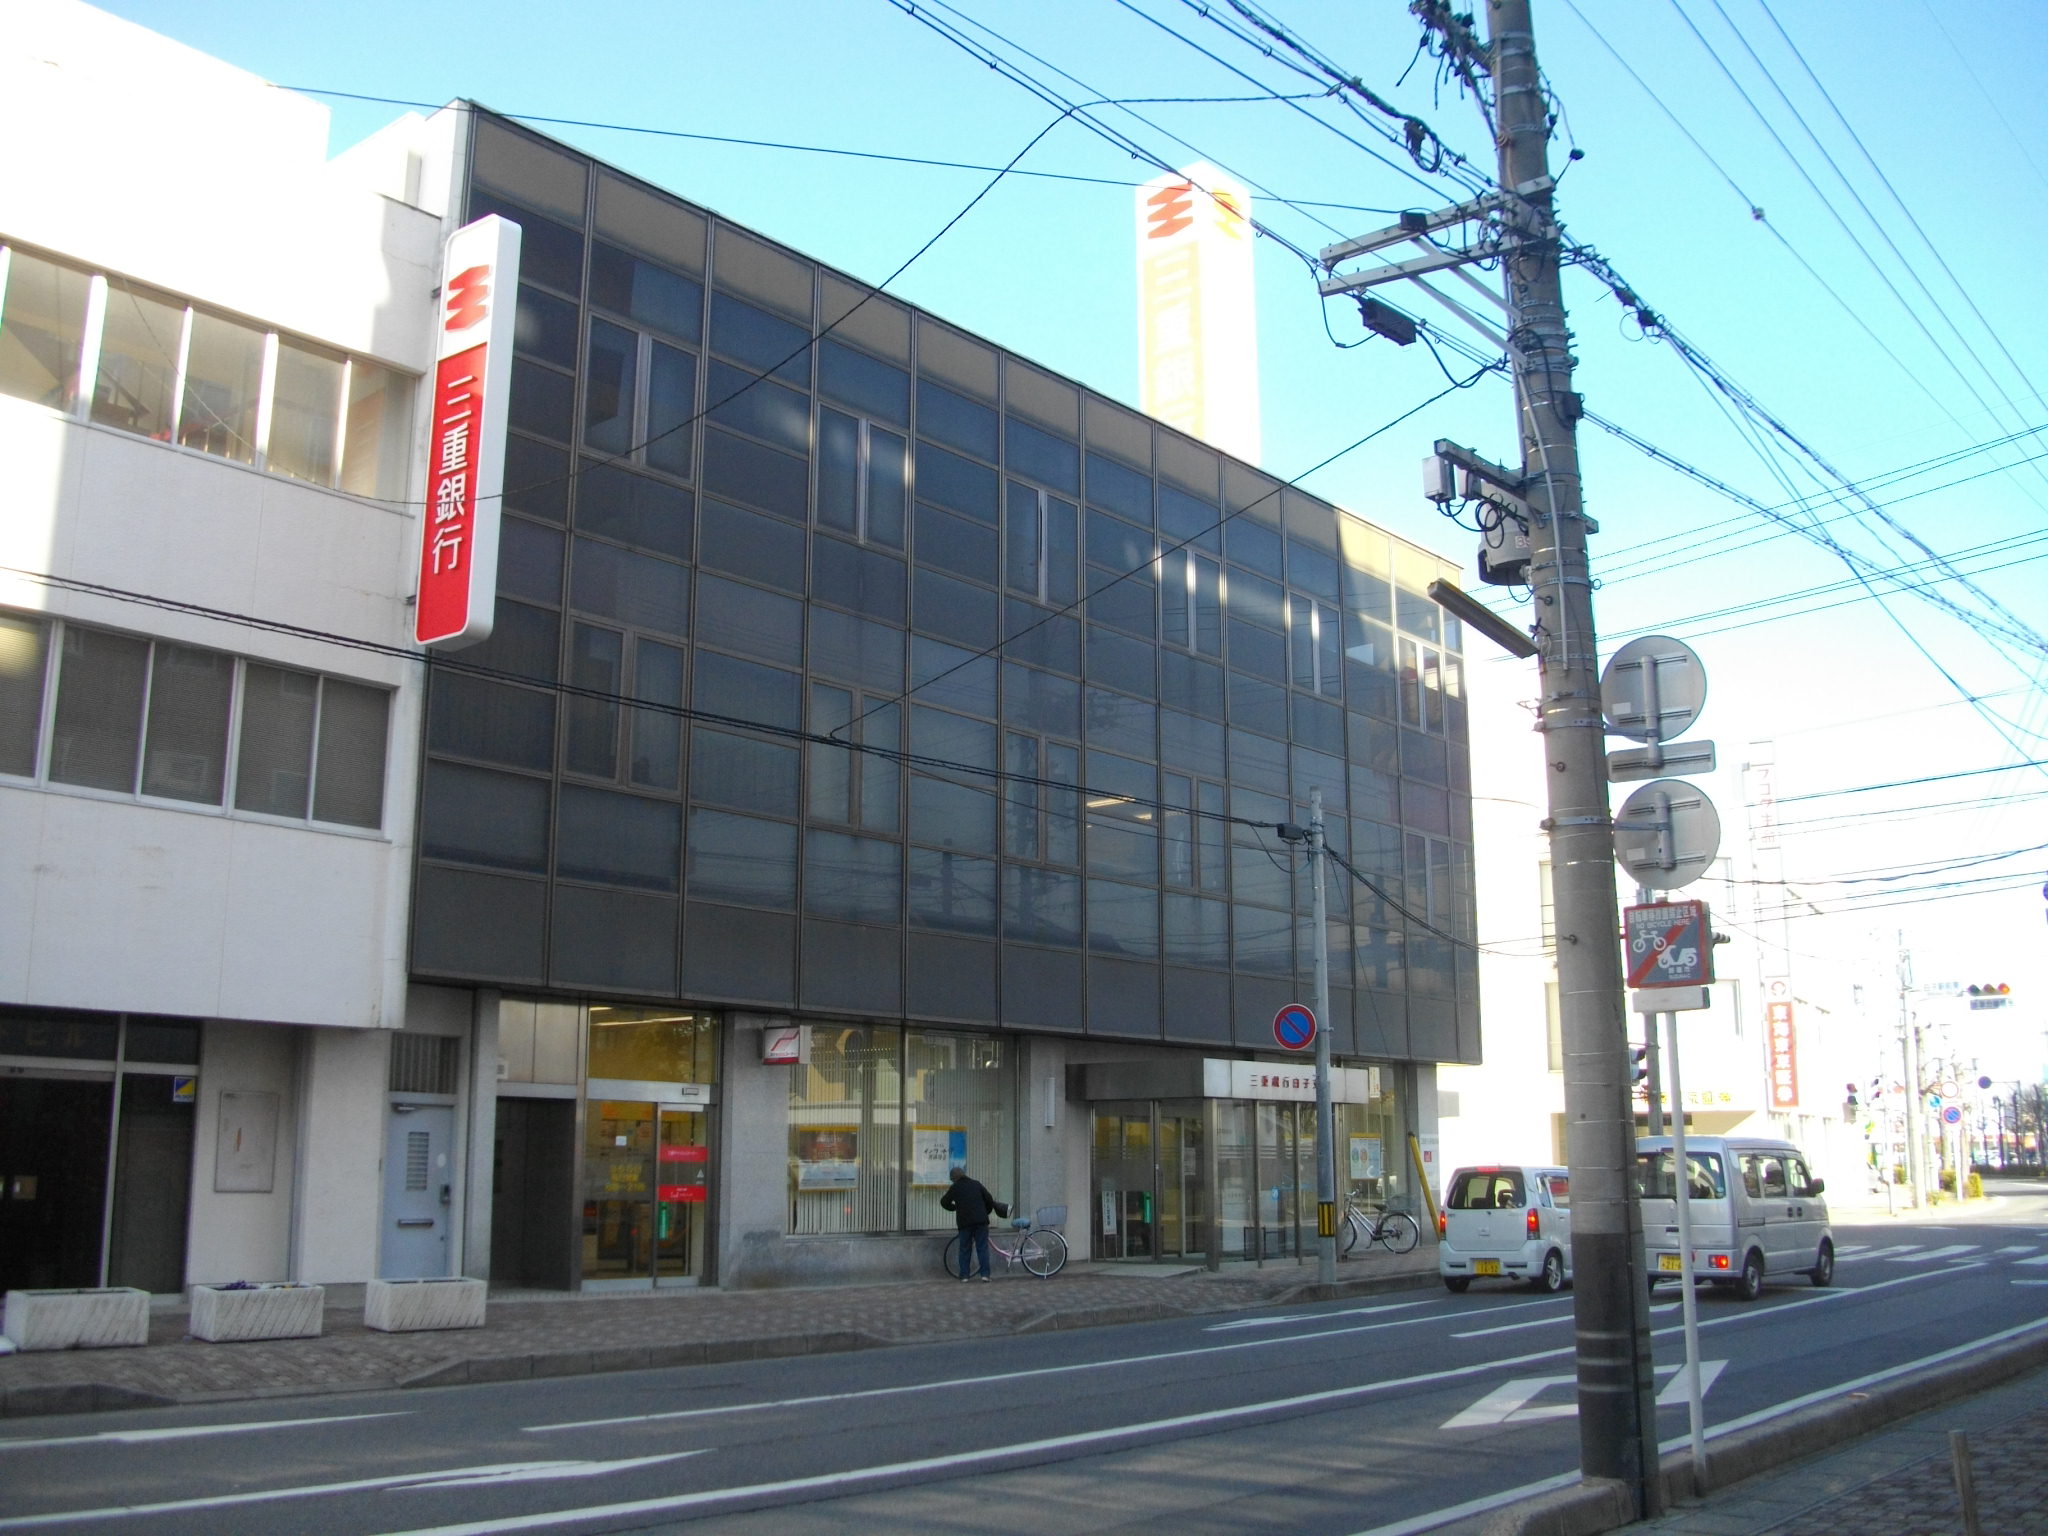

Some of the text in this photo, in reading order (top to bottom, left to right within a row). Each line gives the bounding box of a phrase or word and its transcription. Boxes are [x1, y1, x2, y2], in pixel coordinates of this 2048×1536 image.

[431, 374, 474, 575] 三重銀行
[1647, 920, 1672, 929] BICYCLE
[1674, 918, 1691, 926] HERE
